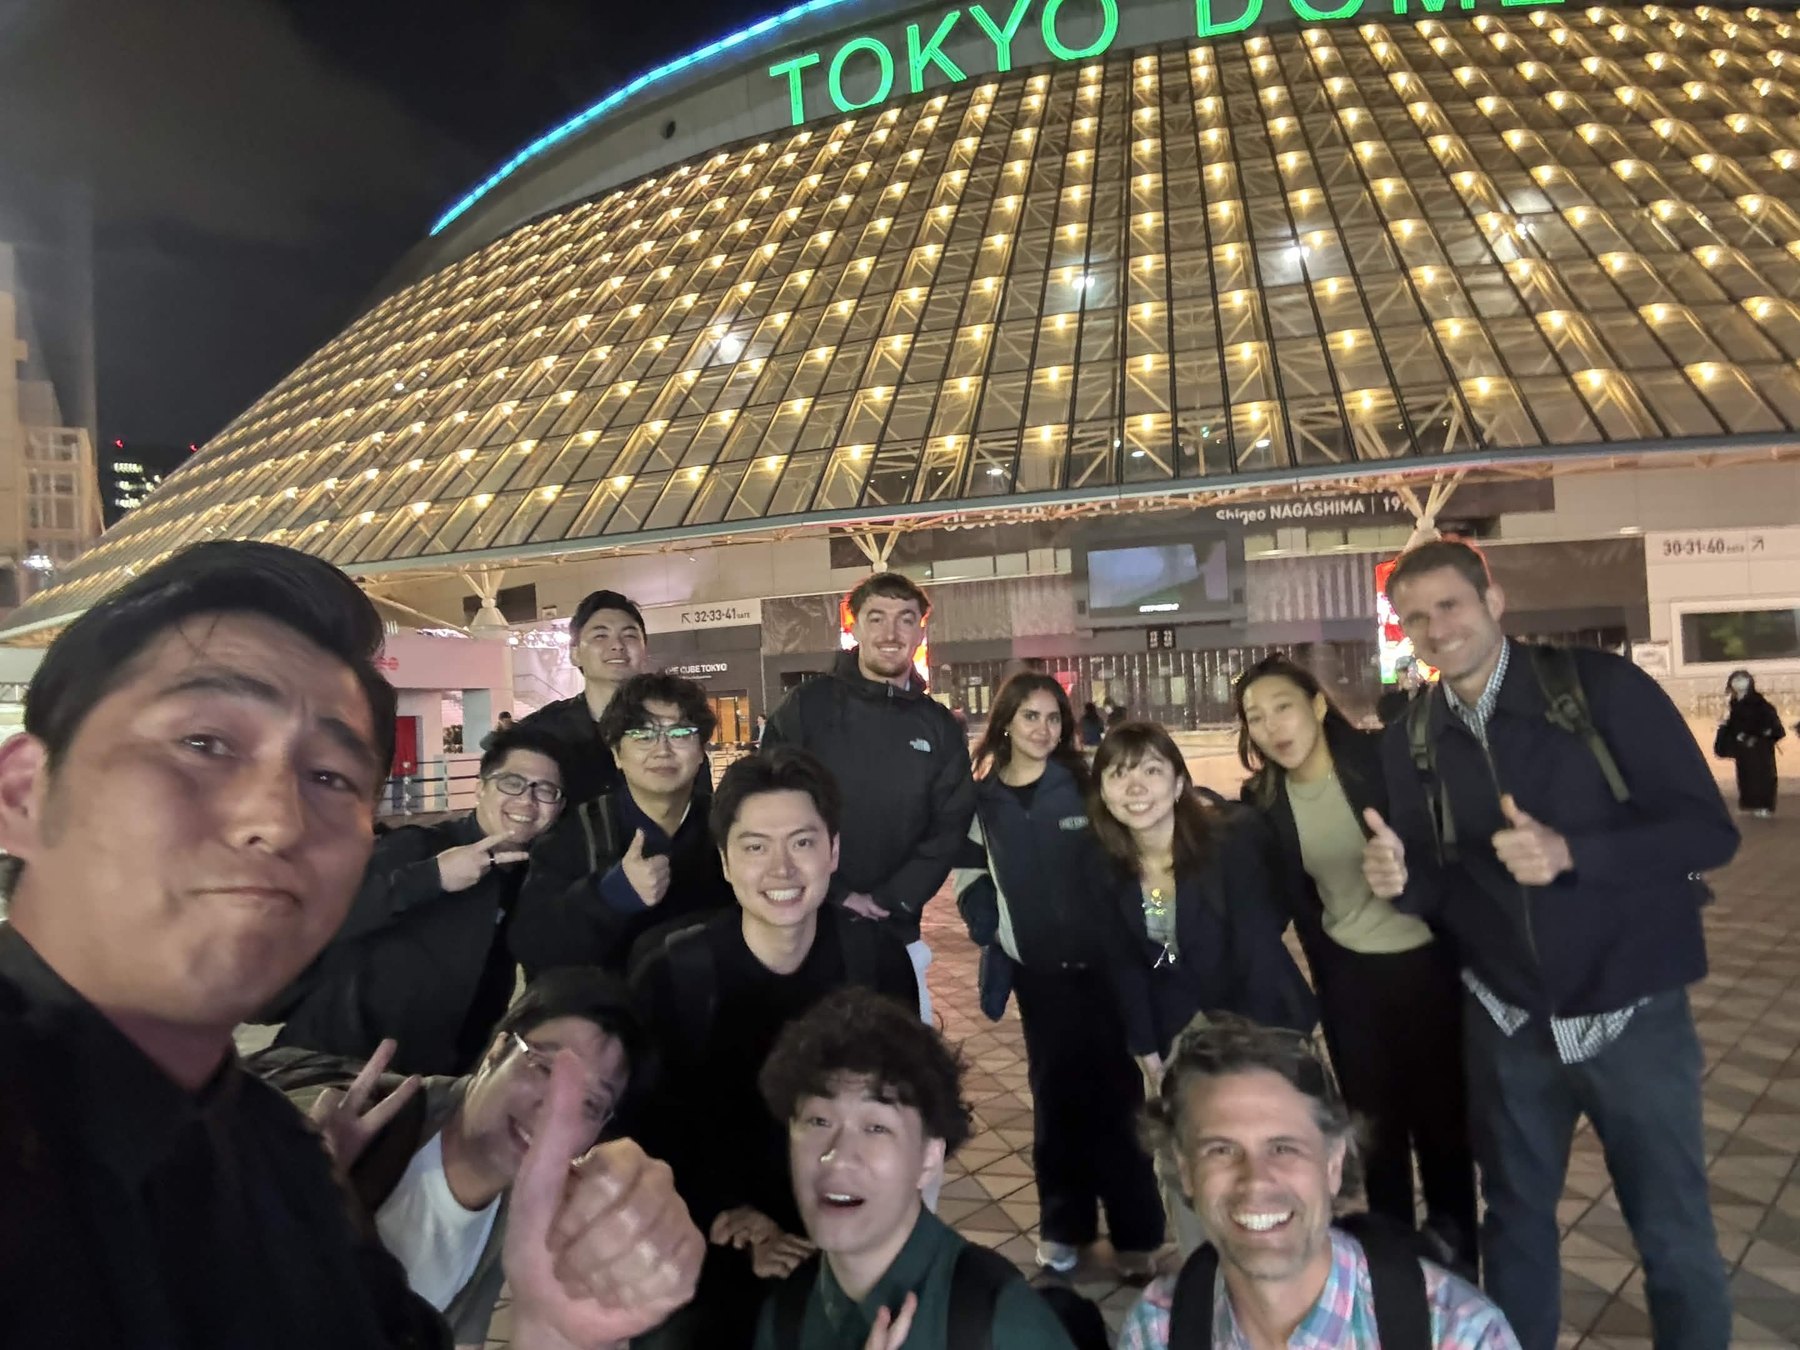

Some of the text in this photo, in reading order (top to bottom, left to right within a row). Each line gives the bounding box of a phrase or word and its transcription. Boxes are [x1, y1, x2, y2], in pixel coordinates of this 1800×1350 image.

[769, 0, 1119, 126] TOKYO
[1270, 500, 1365, 519] NAGASHIMA
[680, 664, 701, 674] CUBE
[701, 662, 728, 673] TOKYO
